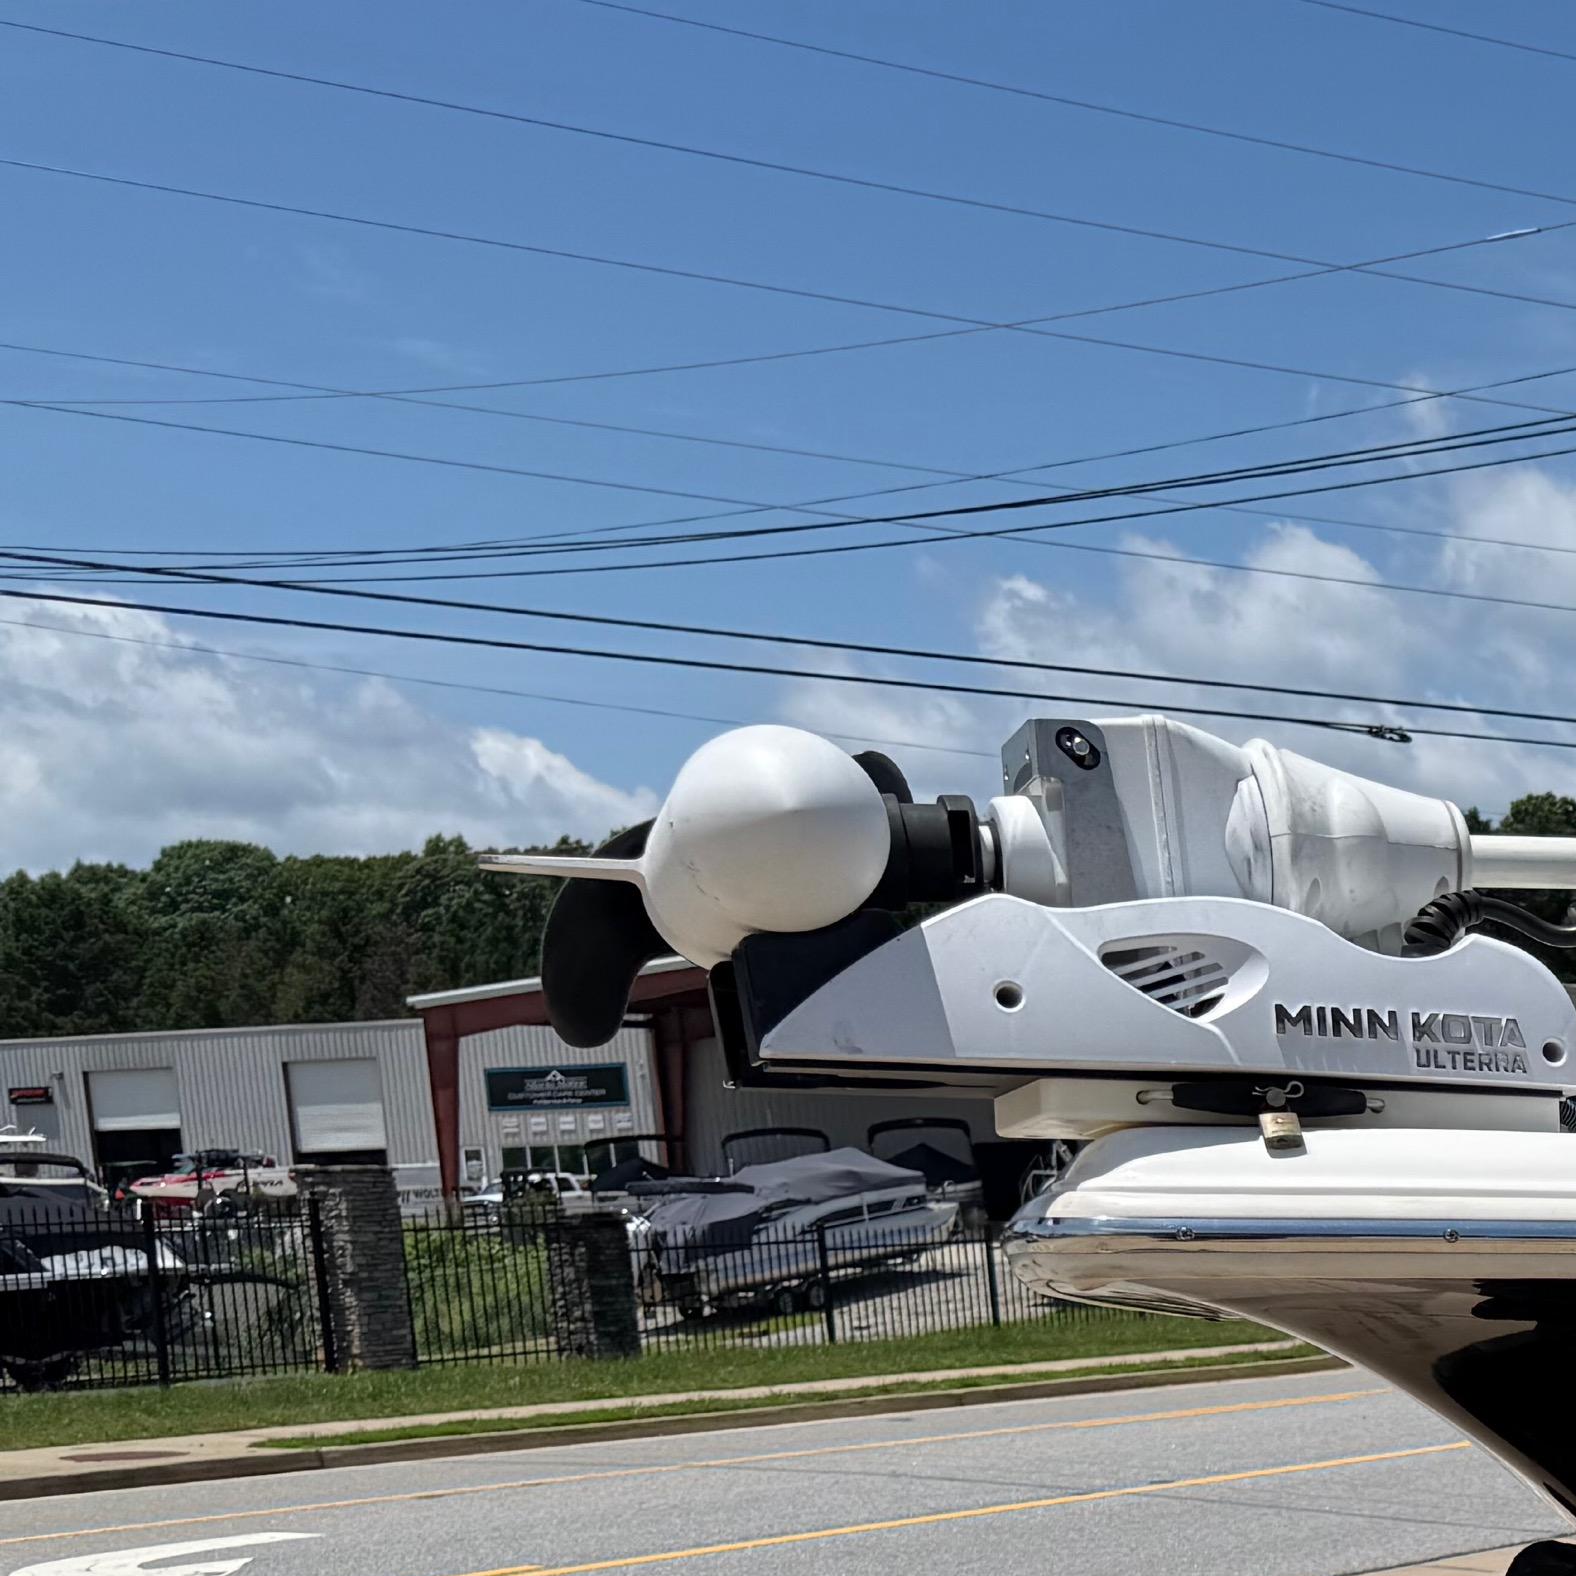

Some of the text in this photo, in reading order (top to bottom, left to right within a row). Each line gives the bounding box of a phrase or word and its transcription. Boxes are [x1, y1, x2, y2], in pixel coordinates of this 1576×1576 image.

[1274, 1003, 1527, 1048] MINN KOTA
[1415, 1048, 1528, 1074] ULTERRA
